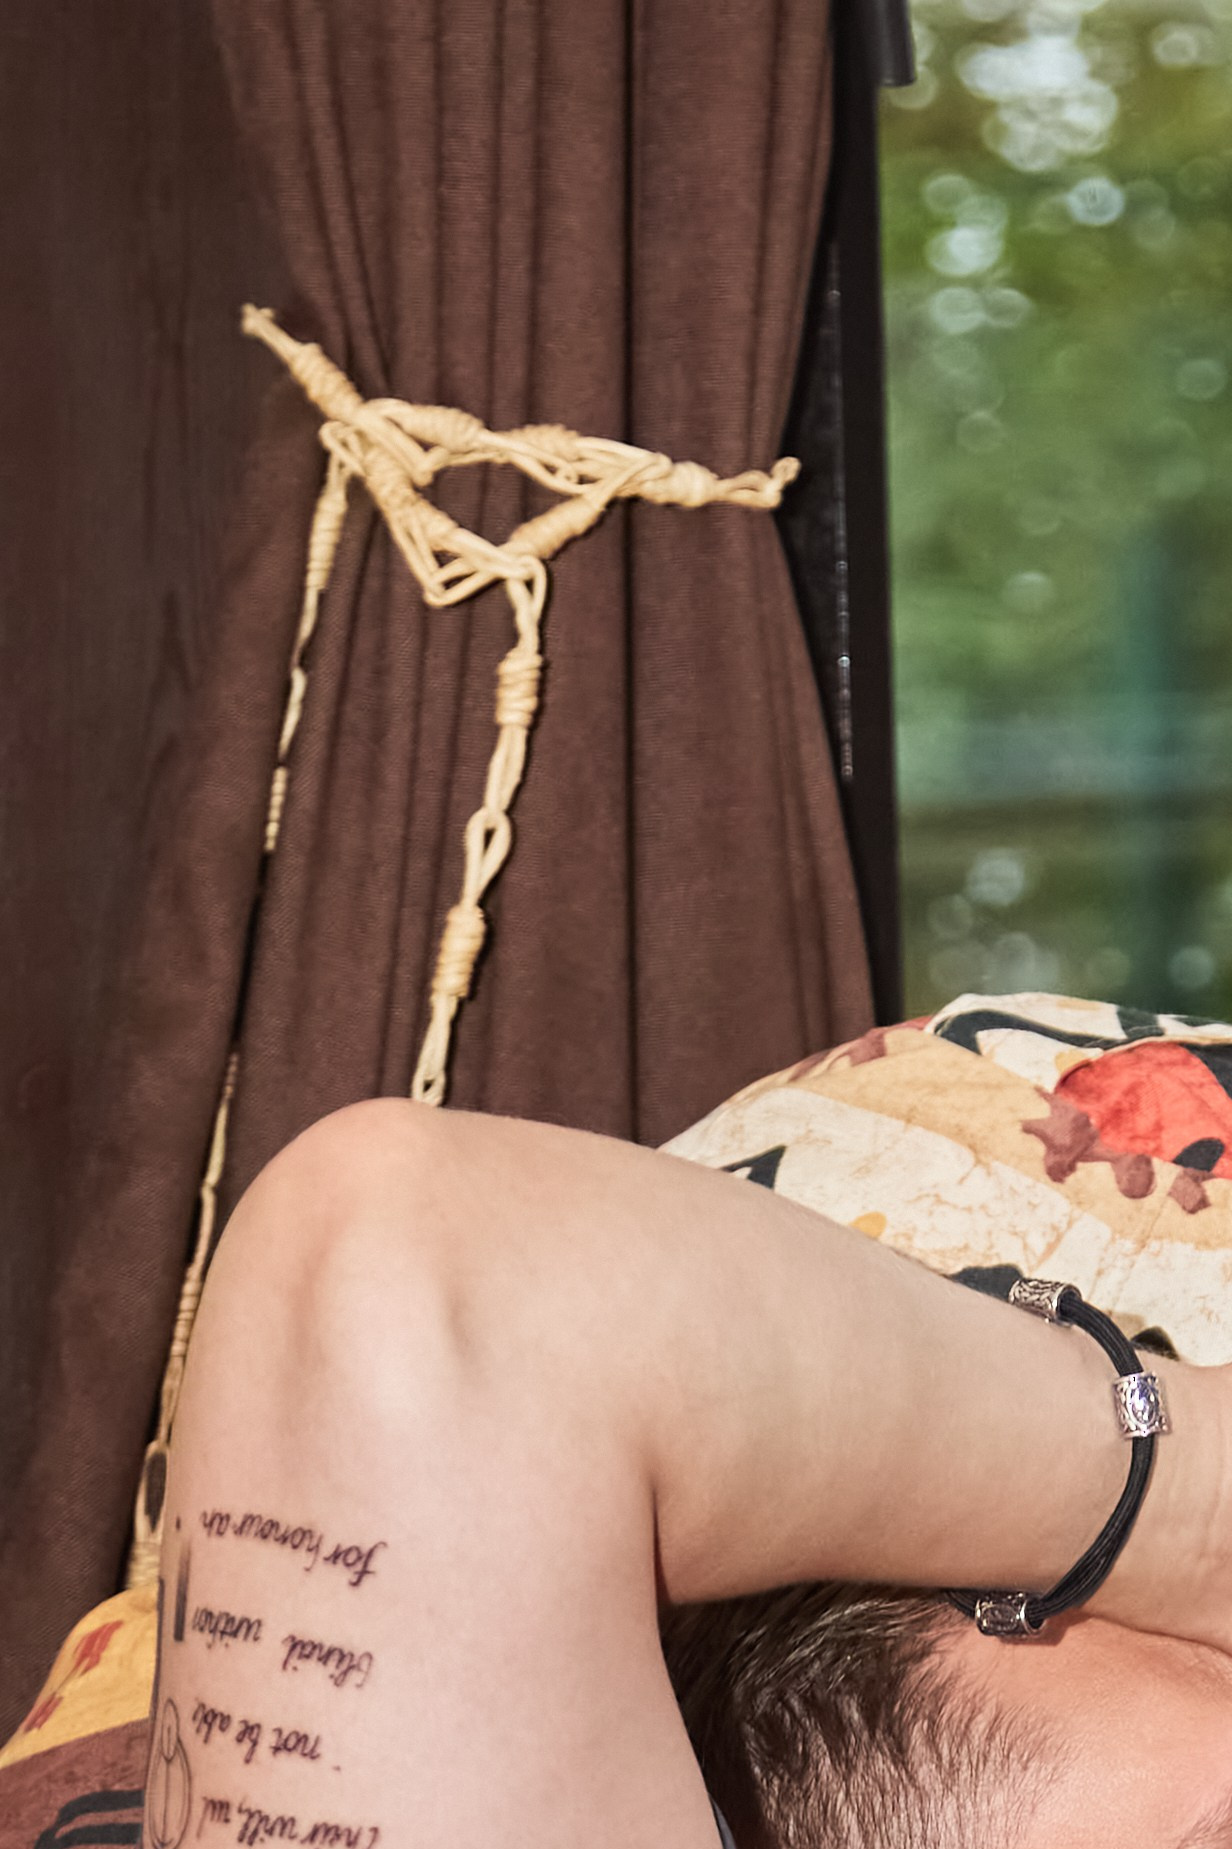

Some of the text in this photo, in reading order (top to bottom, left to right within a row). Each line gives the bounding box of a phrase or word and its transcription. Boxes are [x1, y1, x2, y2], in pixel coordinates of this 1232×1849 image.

[322, 1541, 388, 1588] for
[236, 1718, 262, 1765] be
[270, 1726, 322, 1761] not
